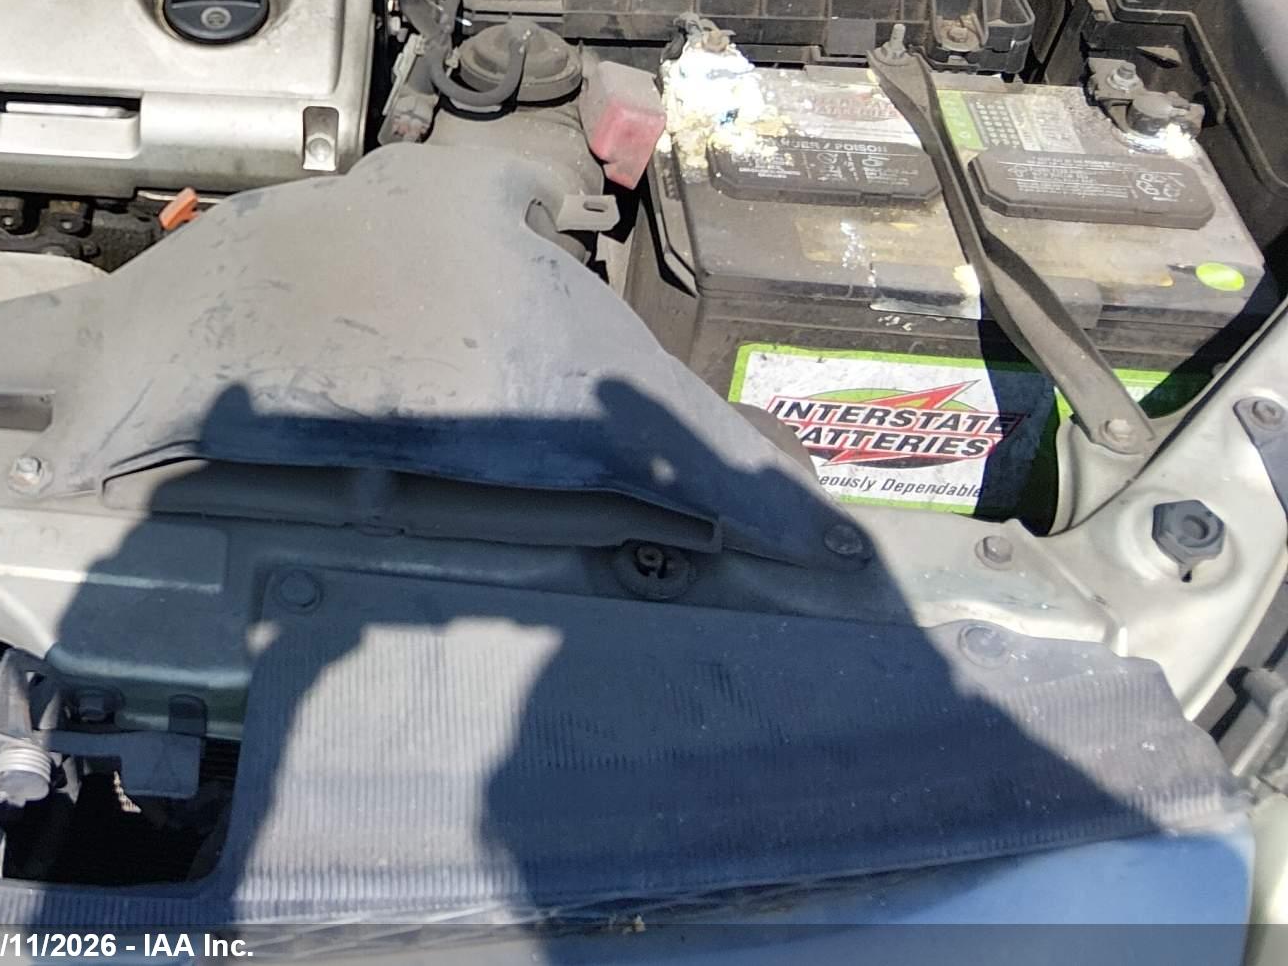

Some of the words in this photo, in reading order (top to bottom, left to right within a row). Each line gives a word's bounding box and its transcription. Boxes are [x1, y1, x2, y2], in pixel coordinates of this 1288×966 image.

[834, 142, 888, 153] POISON
[772, 400, 1014, 433] INTERSTATE
[881, 477, 983, 498] Dependable
